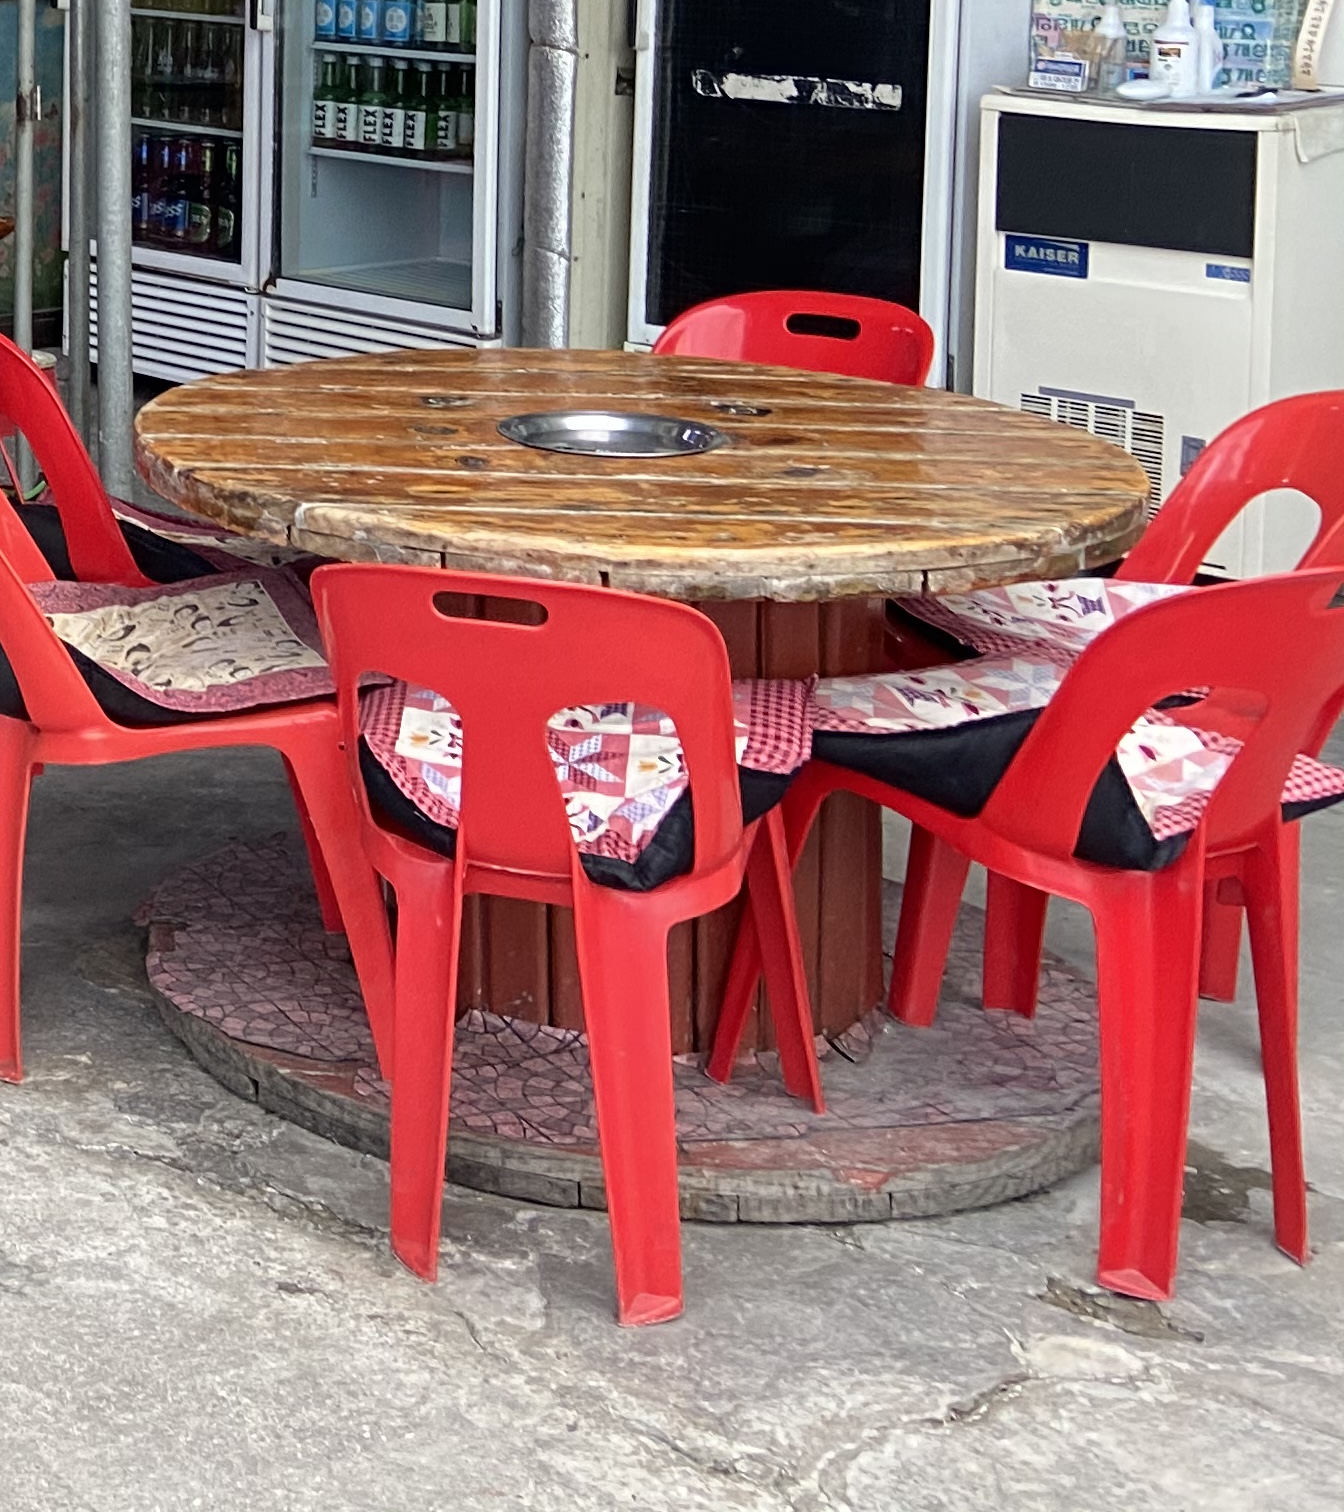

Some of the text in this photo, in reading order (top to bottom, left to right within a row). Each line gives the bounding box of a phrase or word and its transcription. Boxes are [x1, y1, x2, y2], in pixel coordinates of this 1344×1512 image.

[314, 104, 327, 137] FLEX
[363, 108, 378, 142] FLEX
[1014, 244, 1080, 266] KAISER
